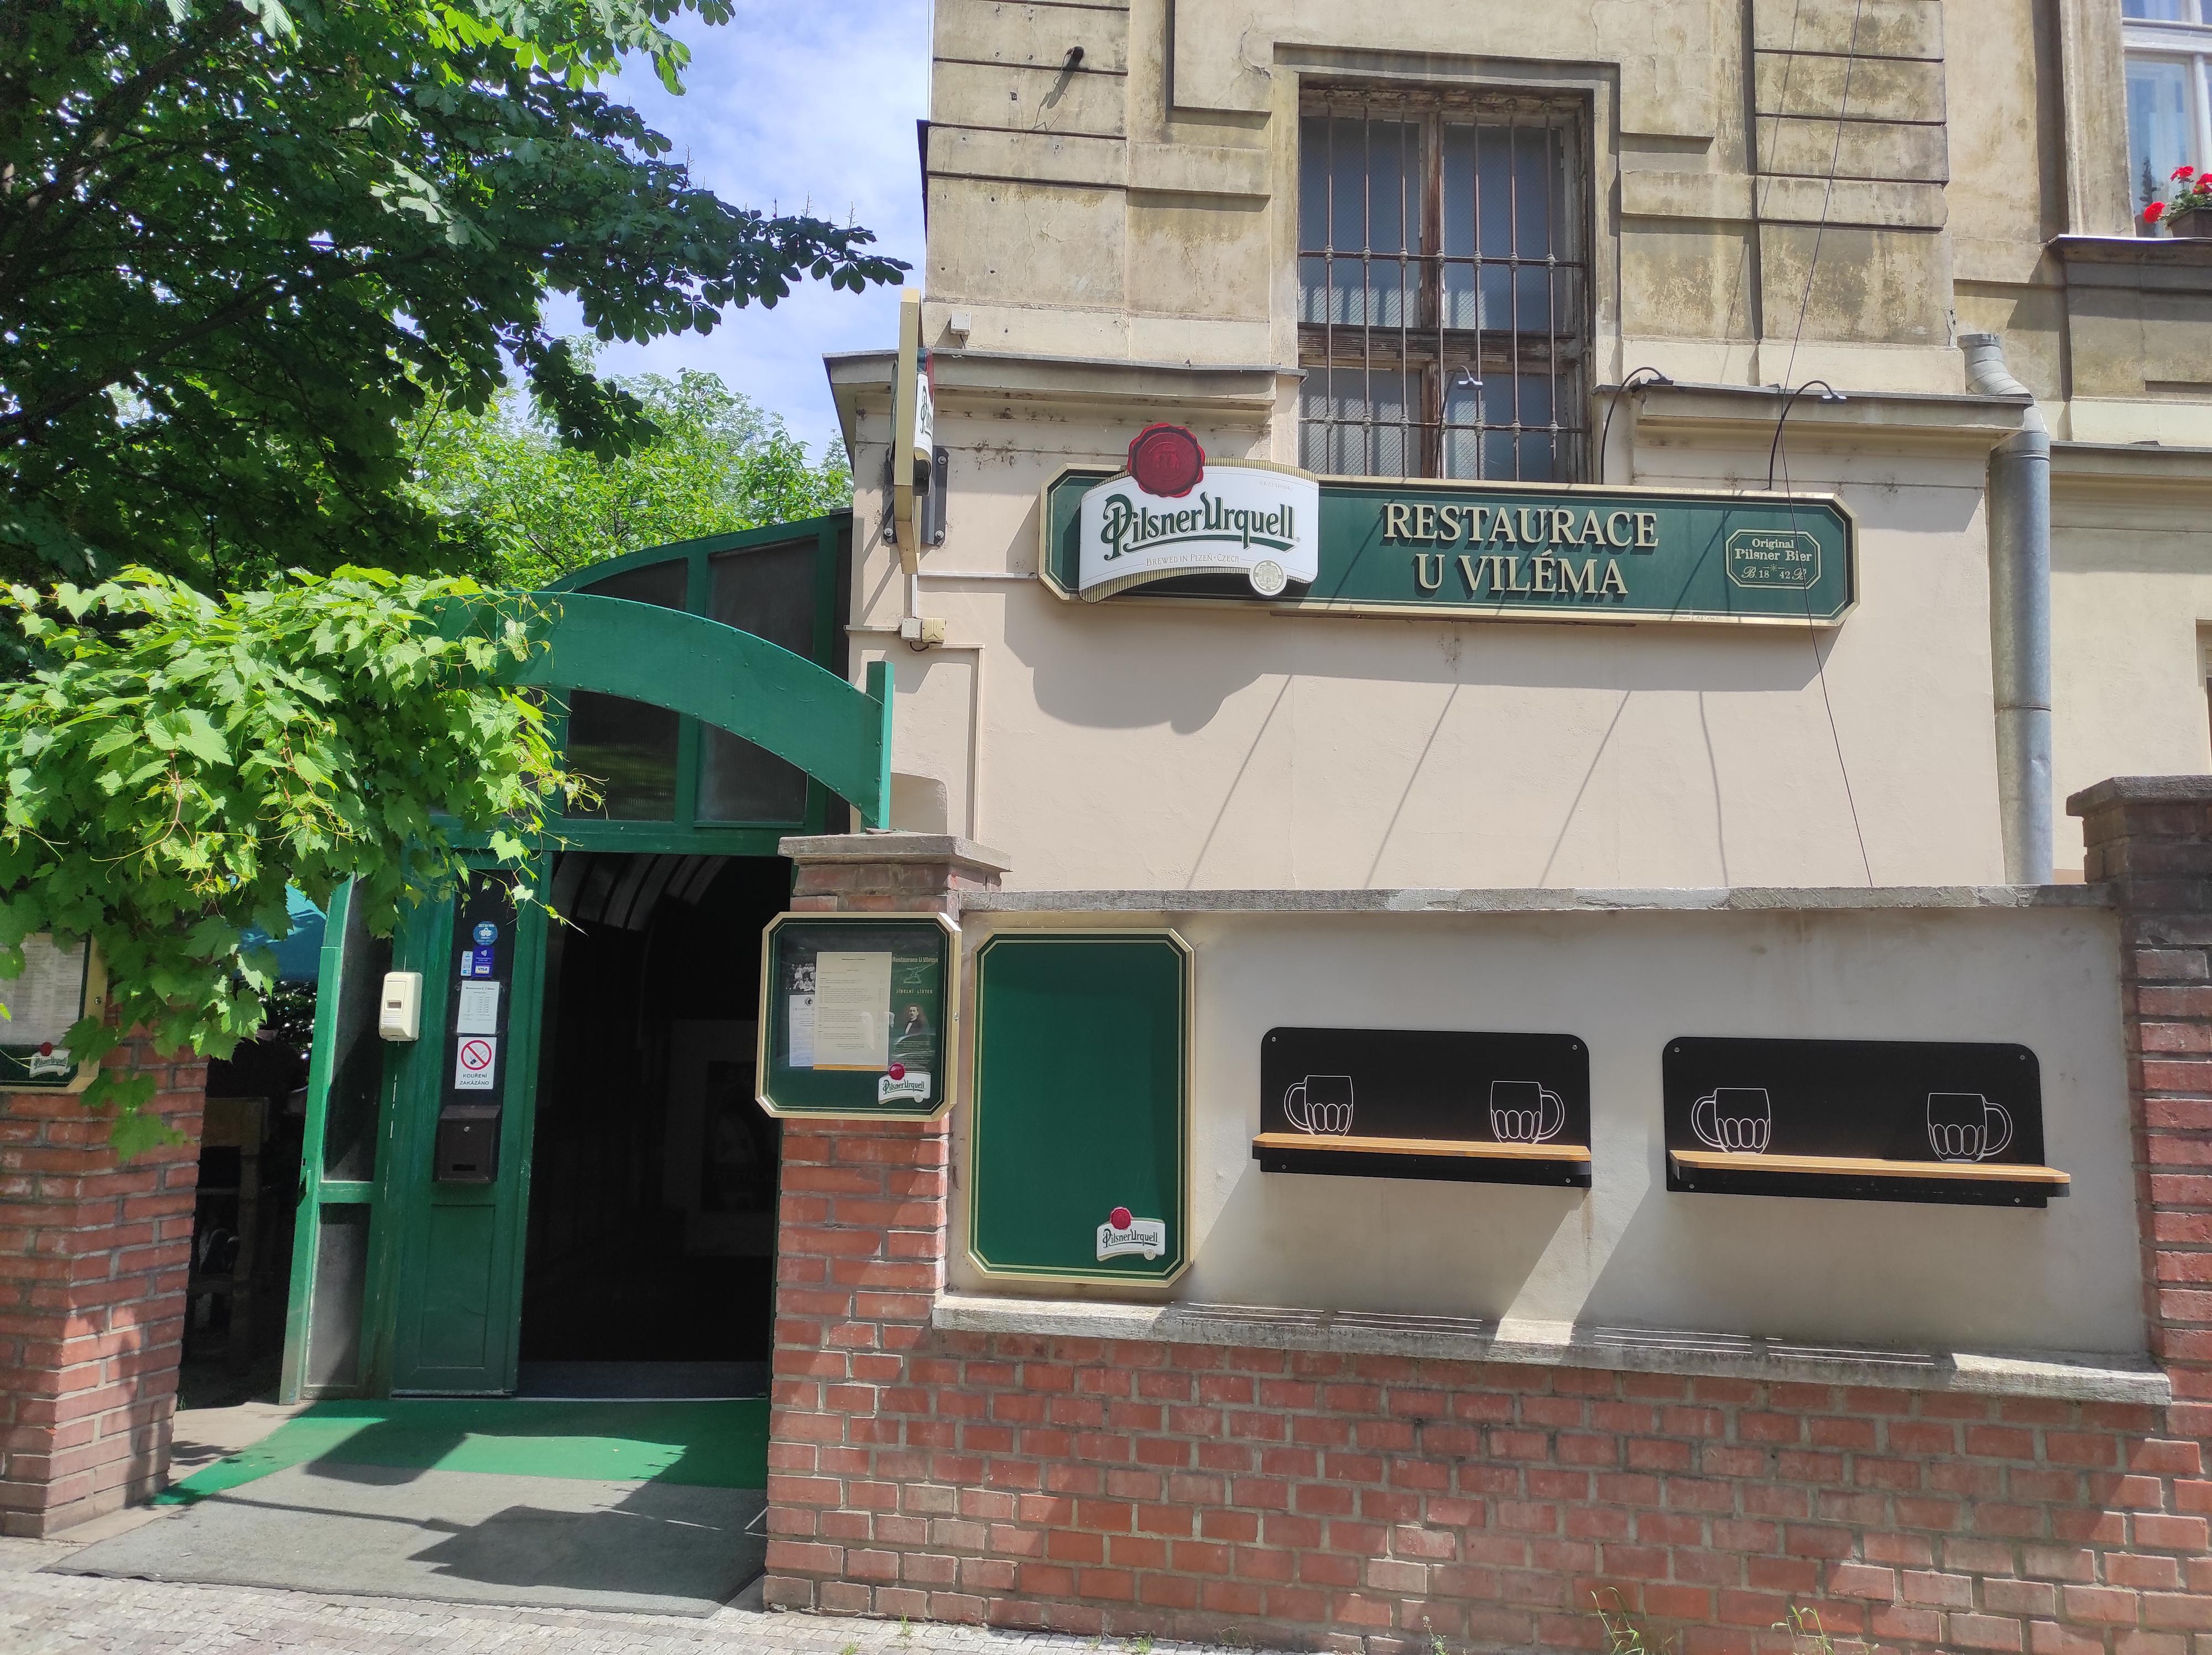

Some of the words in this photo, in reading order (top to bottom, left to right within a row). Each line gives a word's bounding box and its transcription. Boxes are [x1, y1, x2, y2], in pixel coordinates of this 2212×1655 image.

[1100, 494, 1203, 561] Pilsner
[1199, 491, 1297, 550] Urquell
[1384, 503, 1659, 547] RESTAURACE
[1751, 538, 1794, 550] Original
[1146, 556, 1178, 567] BREWED
[1180, 555, 1188, 563] IN
[1735, 548, 1781, 561] Pilsner
[1785, 550, 1813, 562] Bier
[1416, 554, 1445, 589] U
[1458, 549, 1629, 594] VILÉMA
[1759, 570, 1770, 578] 18
[1780, 570, 1791, 579] 42
[883, 1079, 905, 1095] Pilsner
[904, 1079, 925, 1092] Urquell
[1103, 1228, 1131, 1249] Pilsner
[1130, 1229, 1158, 1246] Urquell
